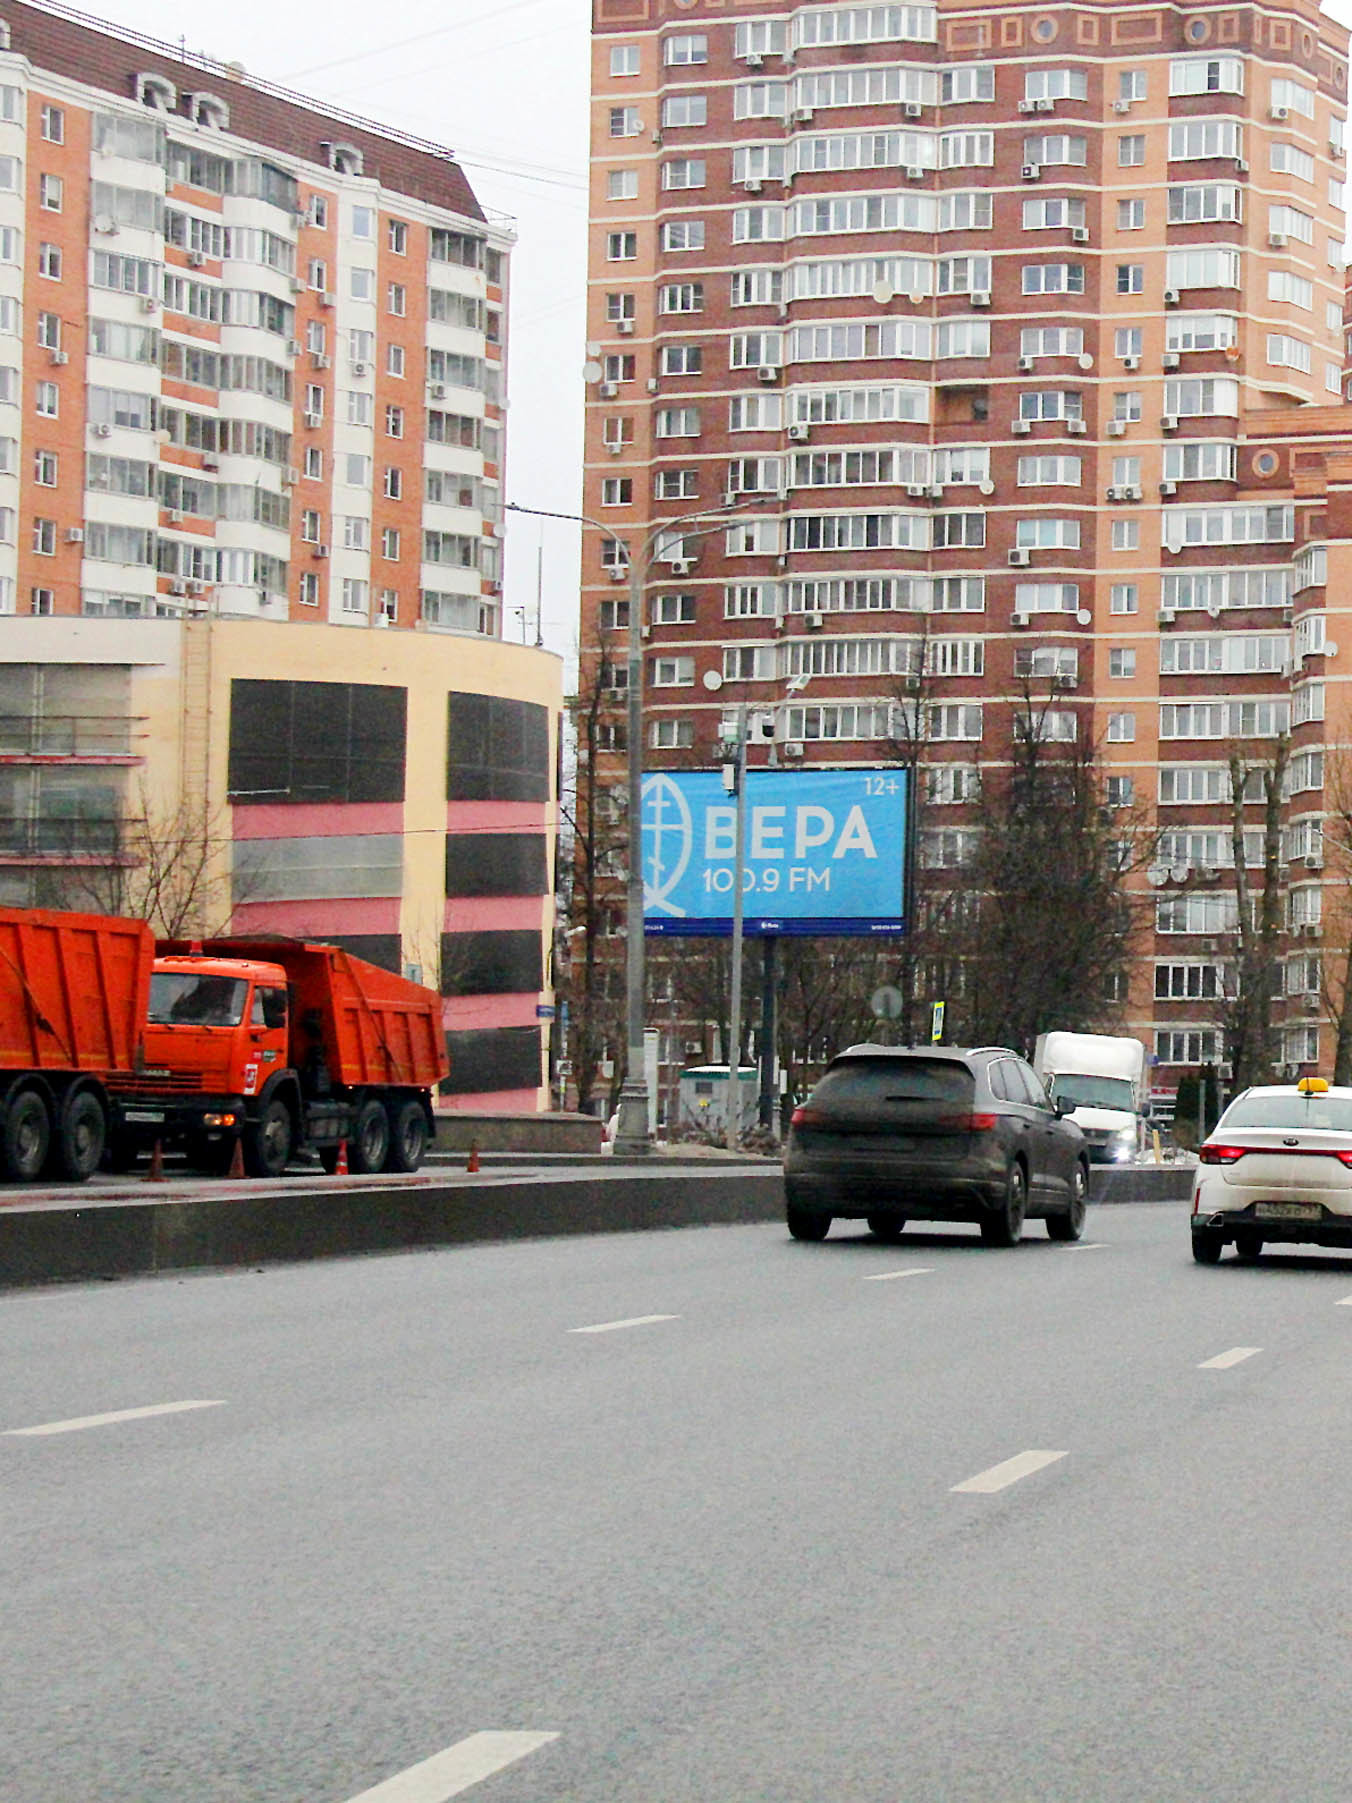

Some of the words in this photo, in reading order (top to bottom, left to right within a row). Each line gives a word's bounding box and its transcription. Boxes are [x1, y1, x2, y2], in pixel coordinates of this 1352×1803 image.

[864, 777, 900, 796] 12+
[704, 804, 878, 860] ВЕРА
[702, 867, 781, 893] 100.9
[788, 867, 831, 892] FM
